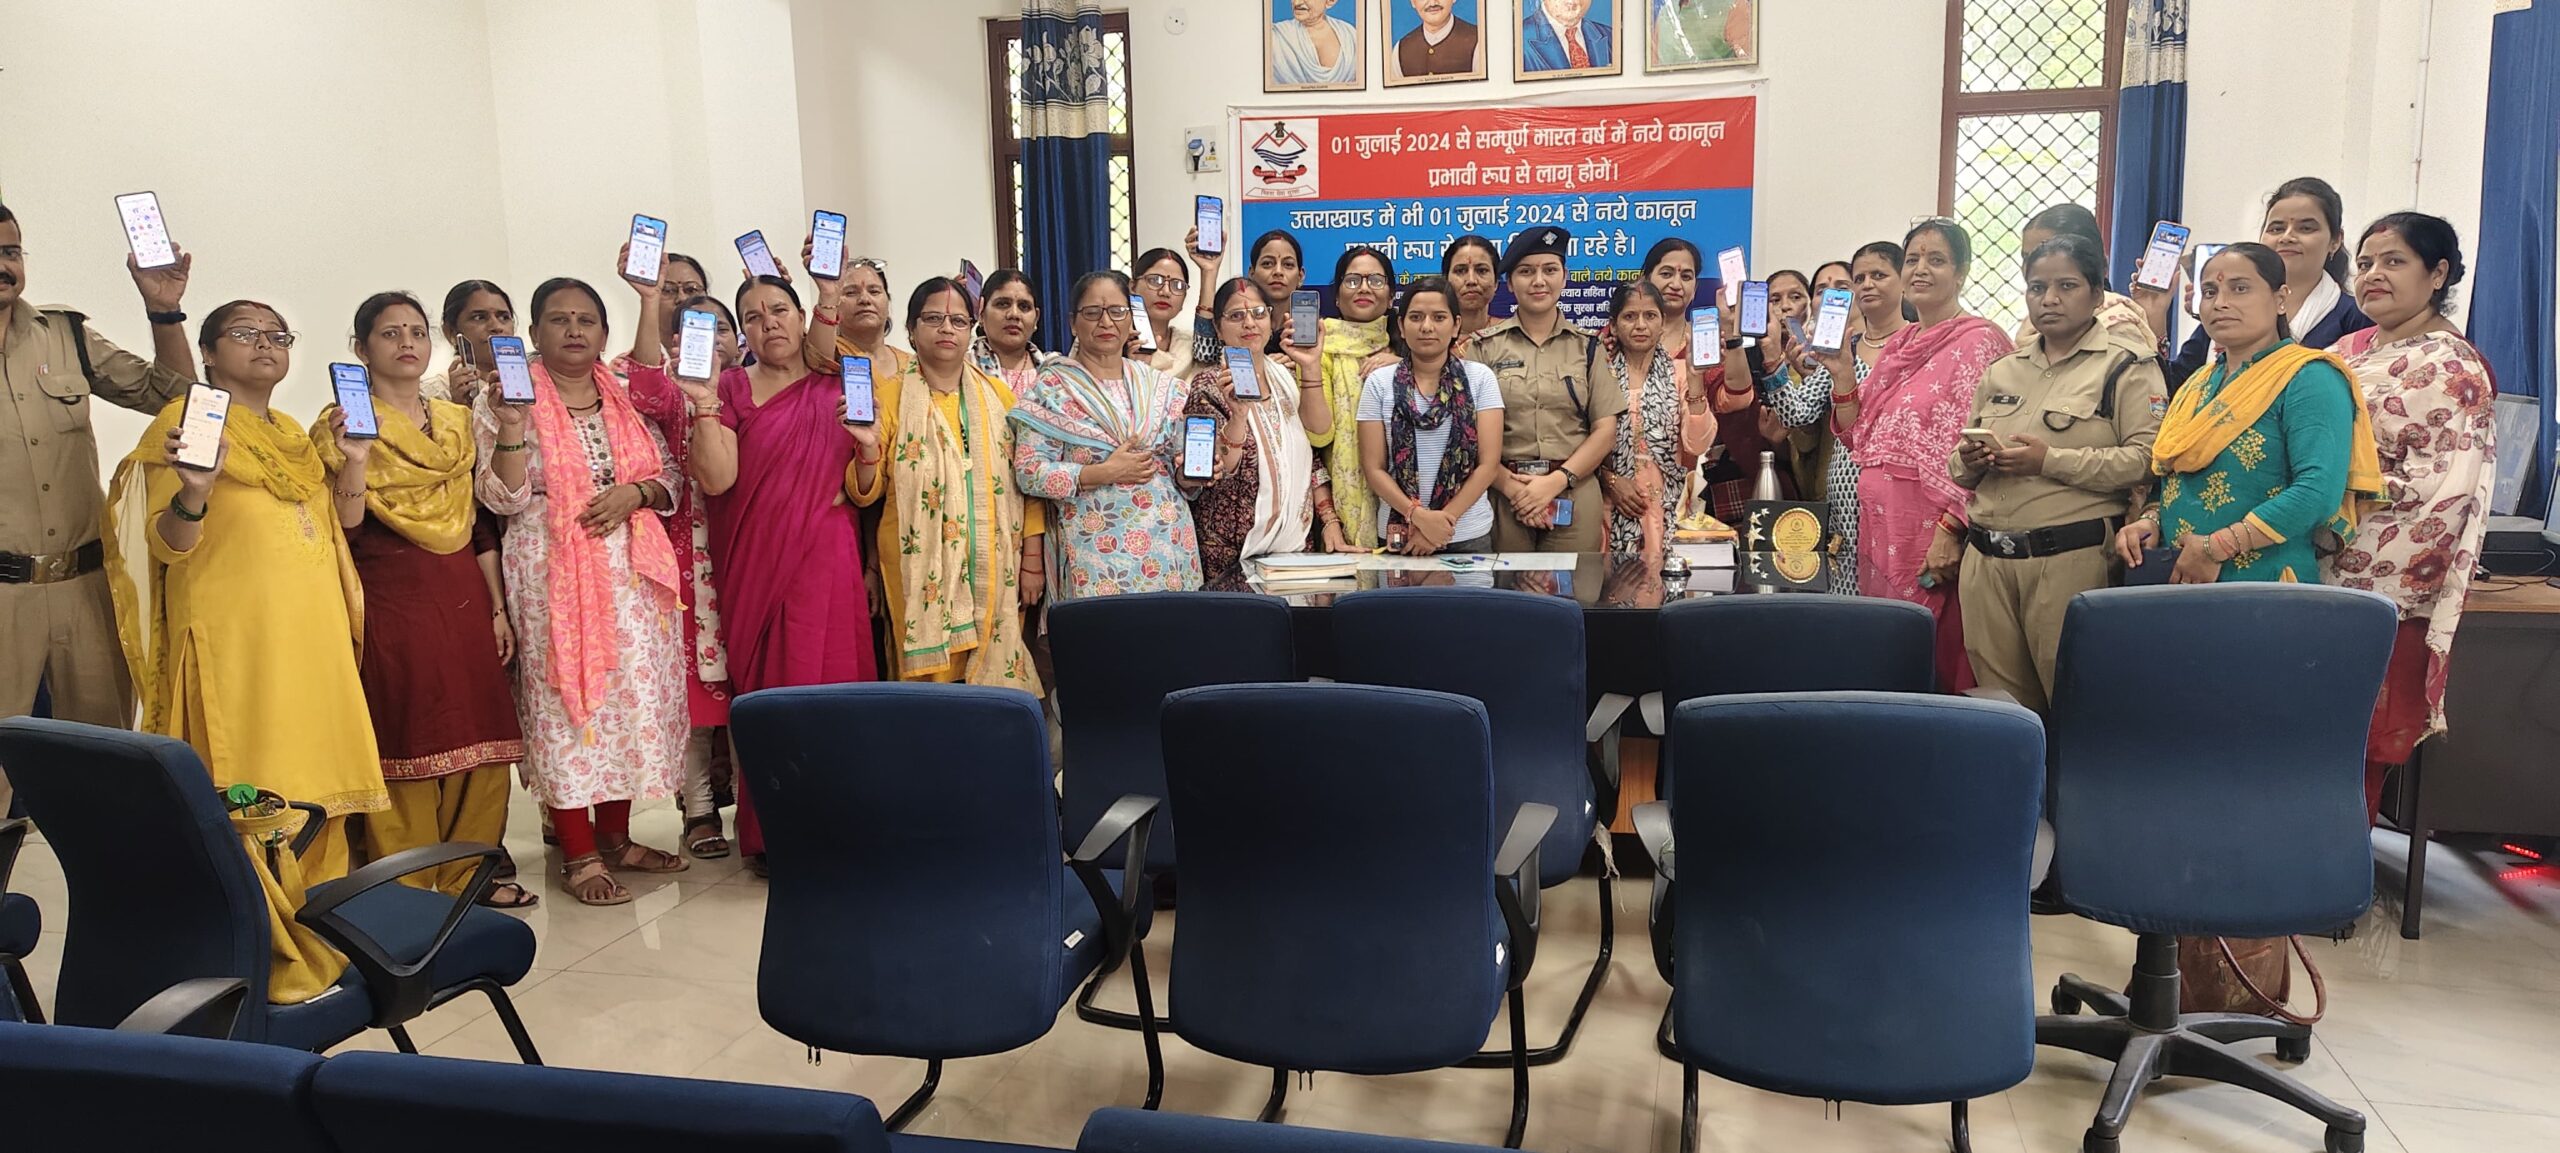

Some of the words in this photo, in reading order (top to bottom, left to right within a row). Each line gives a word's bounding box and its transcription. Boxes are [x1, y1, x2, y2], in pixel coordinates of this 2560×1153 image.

[1332, 137, 1349, 153] 01
[1355, 128, 1402, 158] जुलाई
[1407, 133, 1450, 151] 2024
[1456, 126, 1471, 149] से
[1476, 122, 1530, 154] सम्पूर्ण
[1534, 128, 1577, 146] भारत
[1581, 120, 1606, 144] वर्ष
[1611, 120, 1628, 143] में
[1632, 118, 1663, 143] नये
[1669, 122, 1725, 146] कानून
[1429, 162, 1477, 187] प्रभावी
[1482, 167, 1511, 184] रूप
[1516, 160, 1531, 183] से
[1536, 165, 1575, 188] लागू
[1291, 210, 1374, 228] उत्तराखण्ड
[1379, 203, 1396, 226] में
[1402, 202, 1424, 226] भी
[1430, 208, 1450, 225] 01
[1456, 198, 1510, 231] जुलाई
[1516, 205, 1565, 223] 2024
[1572, 197, 1589, 221] से
[1595, 196, 1628, 220] नये
[1635, 201, 1696, 226] कानून
[1404, 241, 1434, 259] रूप
[1584, 231, 1609, 256] रहे
[1594, 267, 1612, 281] नये
